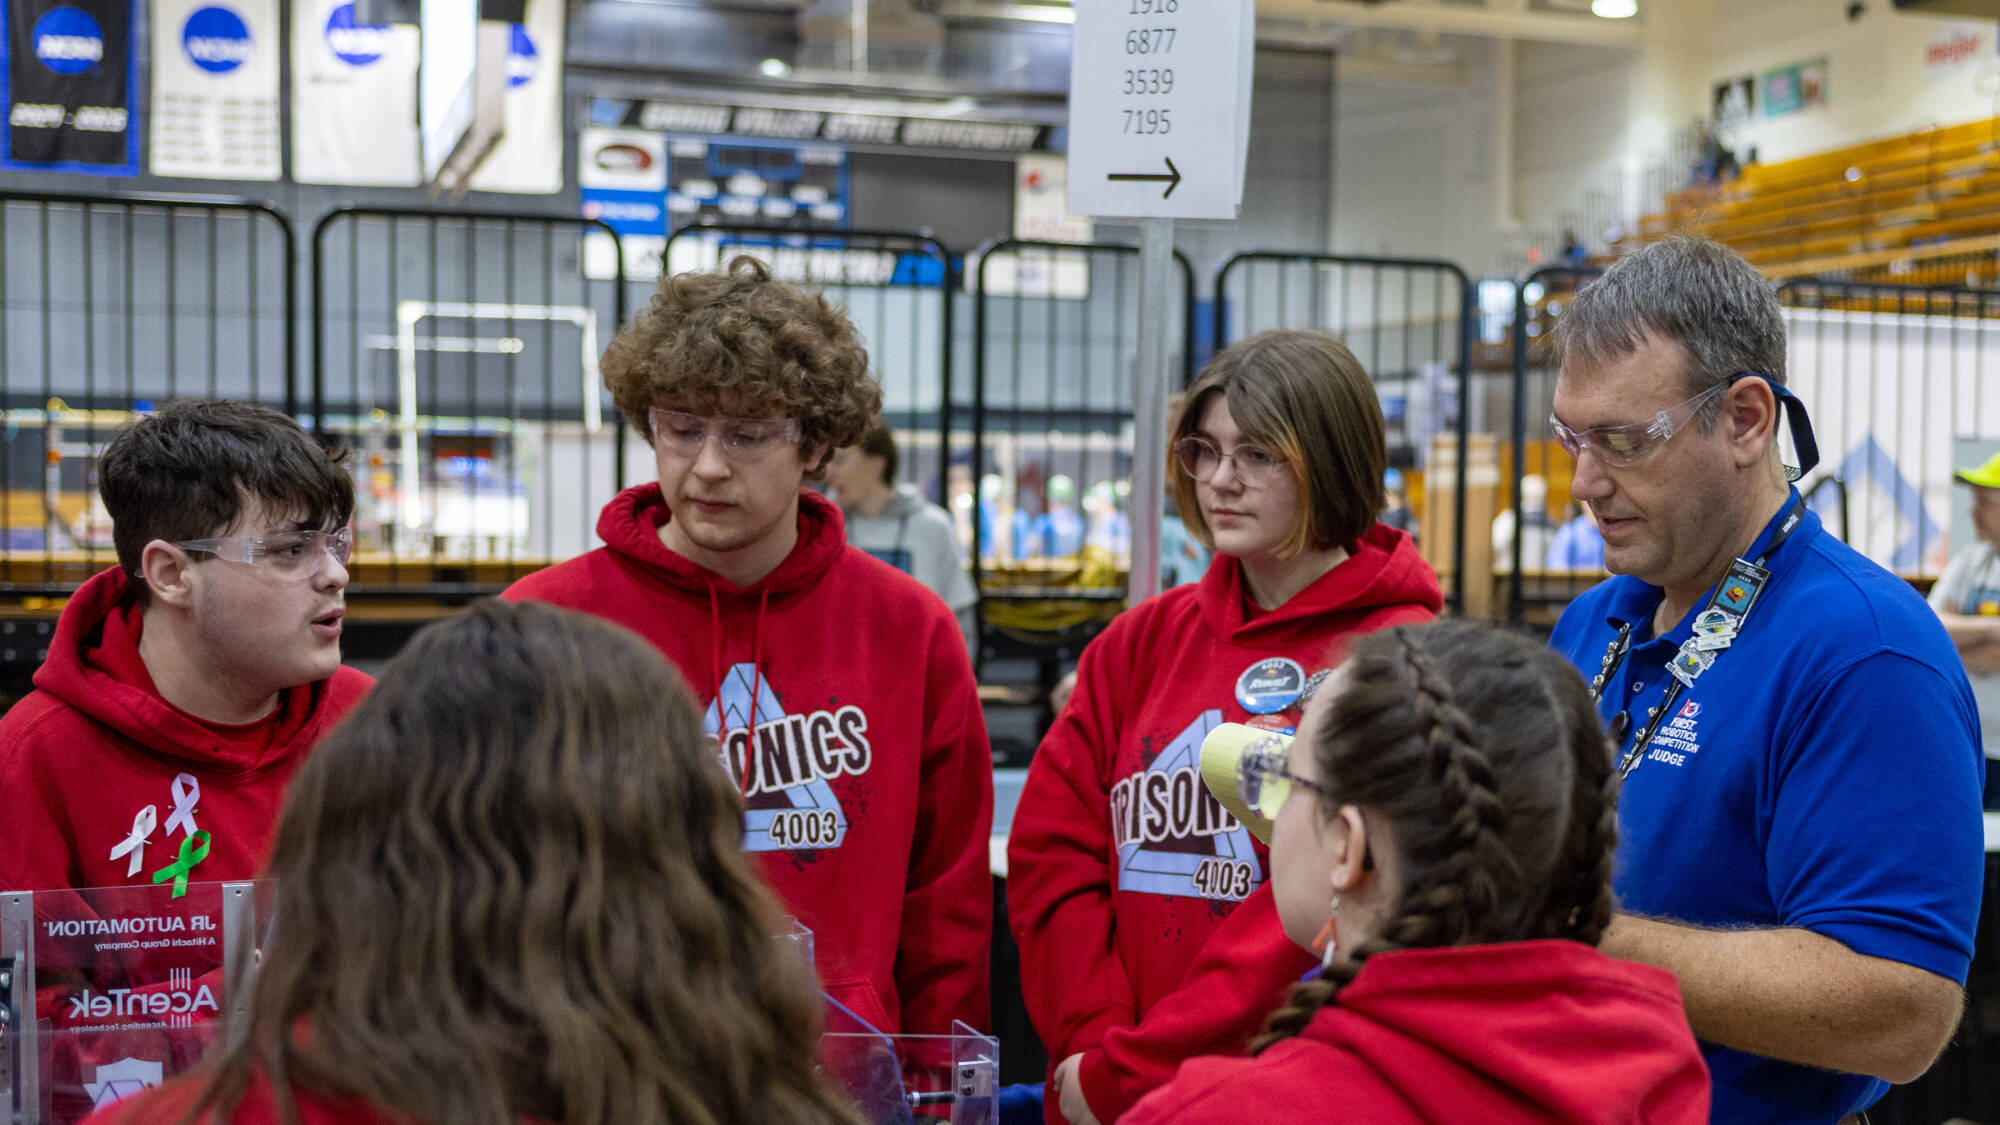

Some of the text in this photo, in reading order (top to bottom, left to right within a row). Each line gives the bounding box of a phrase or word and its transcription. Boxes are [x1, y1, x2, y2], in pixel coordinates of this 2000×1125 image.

[1126, 28, 1176, 55] 6877
[1123, 69, 1174, 94] 3539
[1122, 109, 1171, 134] 7195
[1660, 726, 1697, 742] ROBOTICS
[1670, 717, 1698, 730] FIRST
[706, 706, 871, 796] ONICS
[1648, 749, 1686, 767] JUDGE
[1111, 766, 1241, 850] TRISON
[769, 809, 838, 848] 4003
[1192, 859, 1254, 899] 4003
